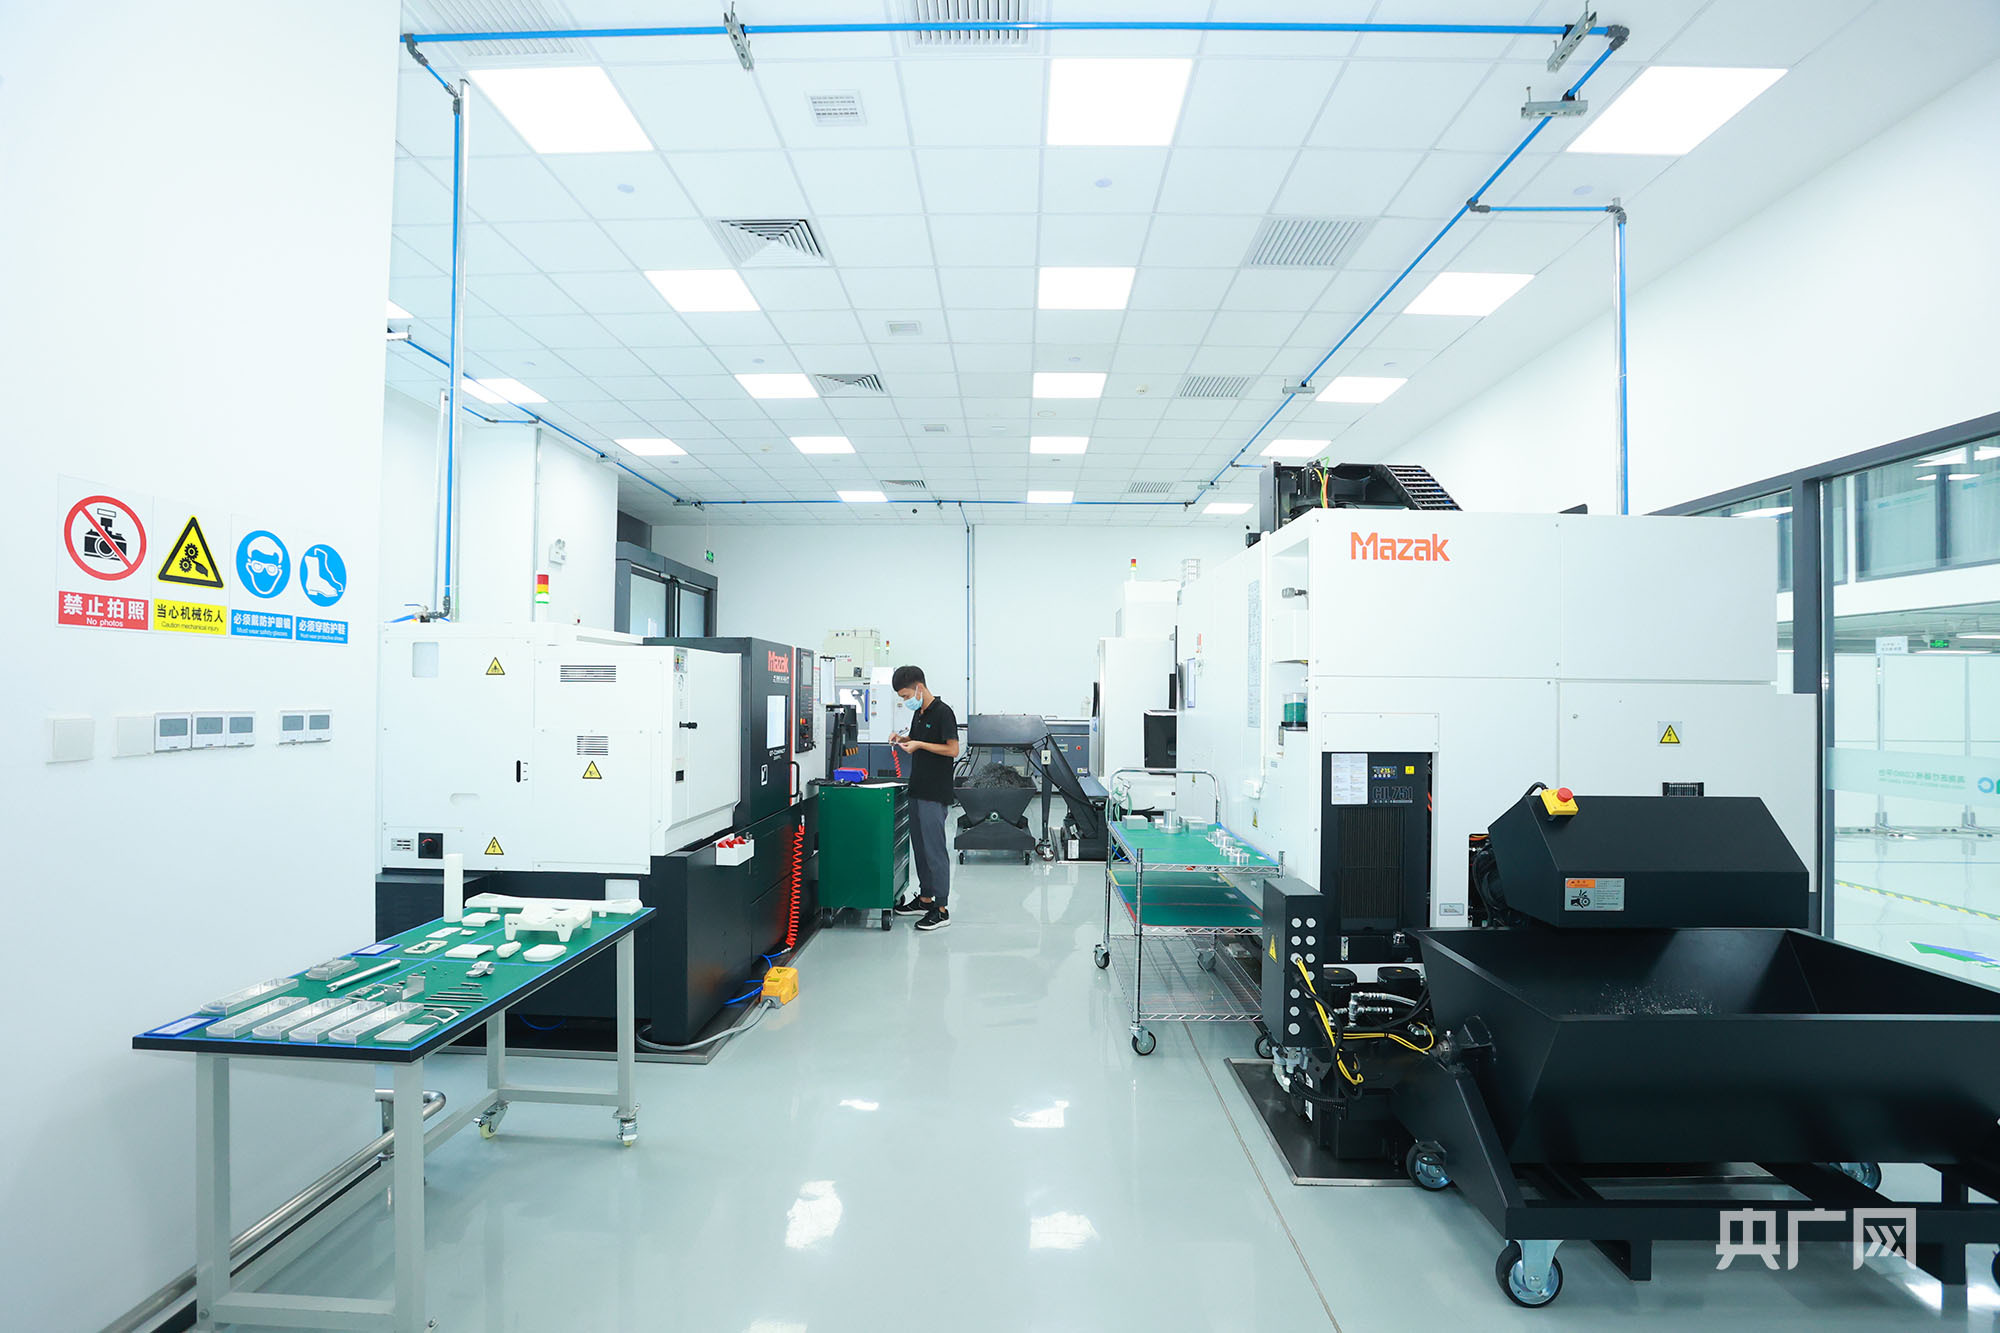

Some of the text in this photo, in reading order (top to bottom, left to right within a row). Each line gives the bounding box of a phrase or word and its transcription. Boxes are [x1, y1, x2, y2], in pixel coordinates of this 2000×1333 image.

[1351, 532, 1450, 561] Mazak
[63, 593, 145, 620] 禁止拍照
[157, 603, 224, 623] 当心机械伤人
[86, 617, 124, 628] No photos
[161, 621, 180, 629] Caution
[233, 612, 292, 630] 必须戴防护眼镜
[768, 650, 789, 673] Mazak
